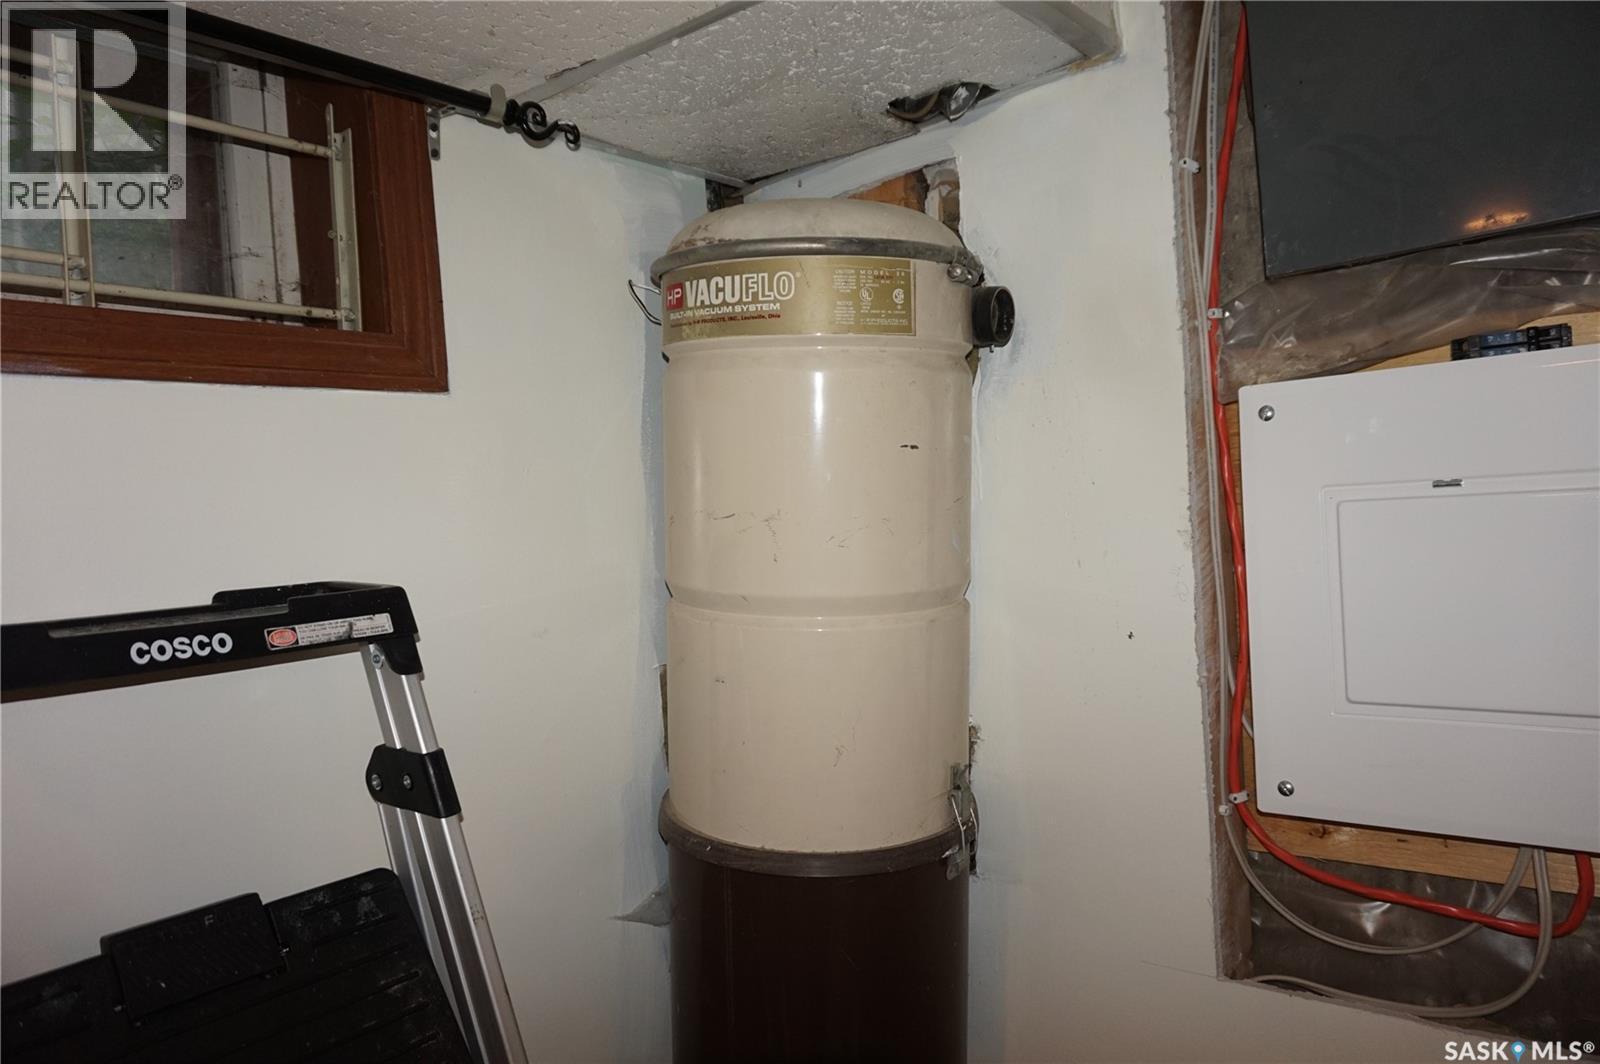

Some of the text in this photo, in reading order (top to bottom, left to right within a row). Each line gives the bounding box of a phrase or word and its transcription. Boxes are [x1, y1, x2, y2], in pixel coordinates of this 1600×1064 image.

[667, 288, 682, 306] HP
[694, 305, 733, 317] VACUUM
[734, 303, 781, 313] SYSTEM
[130, 632, 234, 665] COSCO
